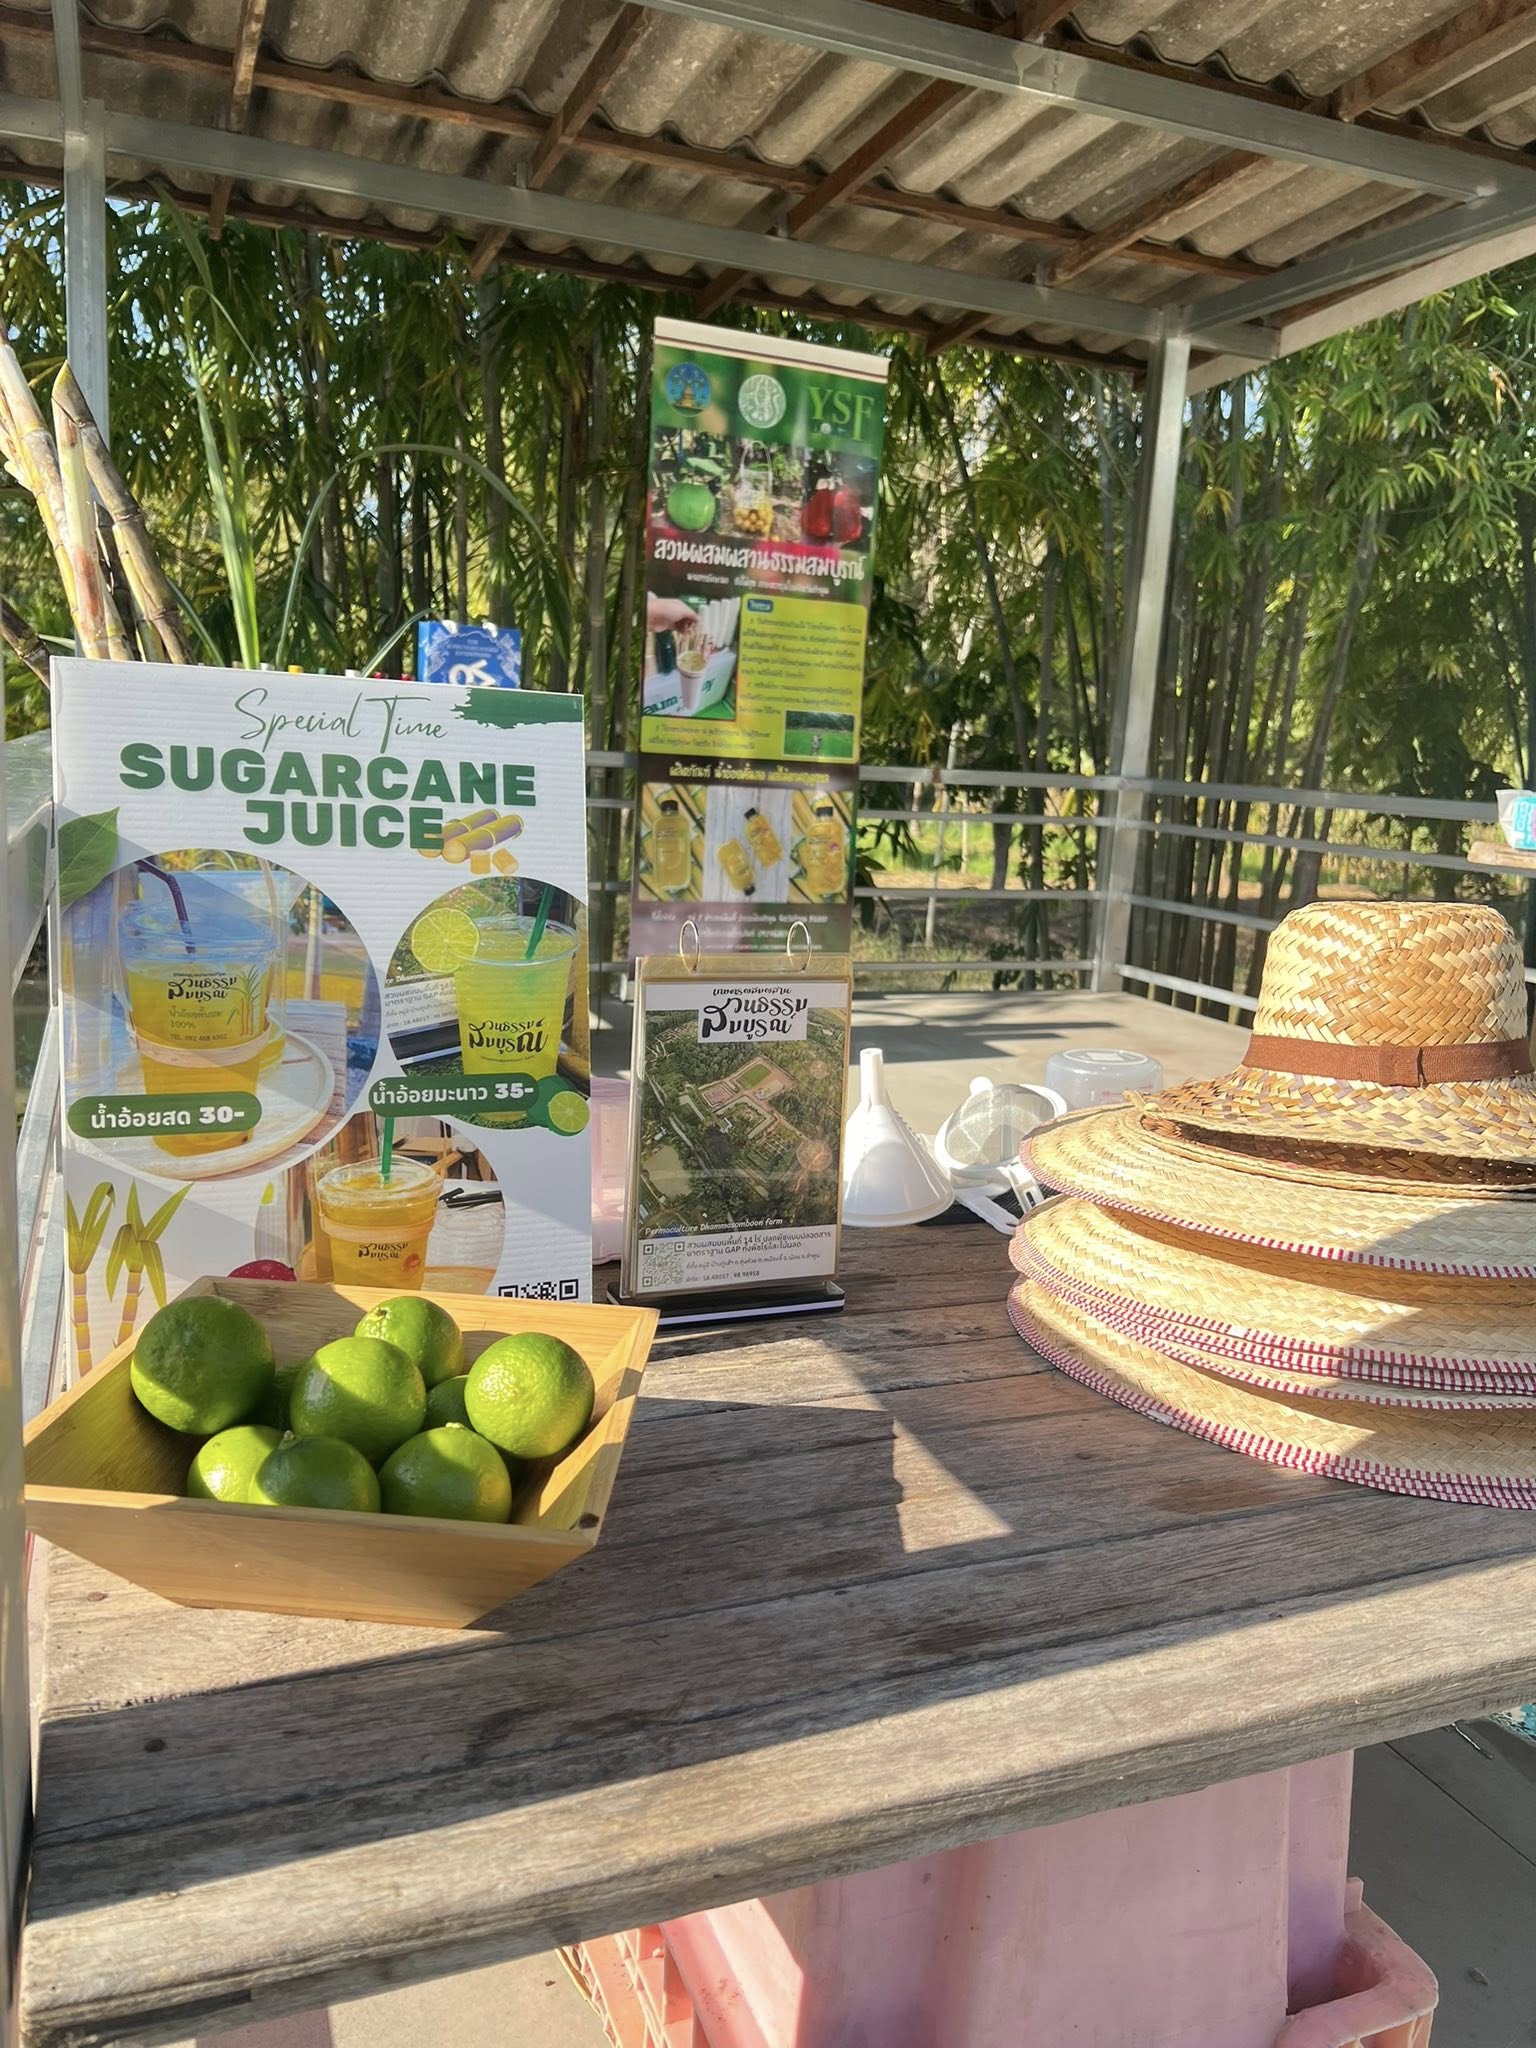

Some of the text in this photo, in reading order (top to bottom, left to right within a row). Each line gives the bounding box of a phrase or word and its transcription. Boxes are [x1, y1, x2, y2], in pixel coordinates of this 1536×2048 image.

[808, 386, 875, 441] YSF
[235, 688, 448, 753] Special Time
[120, 743, 536, 806] SUGARCANE
[243, 800, 443, 849] JUICE
[91, 1103, 191, 1129] น้ำอ้อยสด
[373, 1081, 488, 1105] น้ำอ้อยมะนาว
[725, 1245, 740, 1254] GAP
